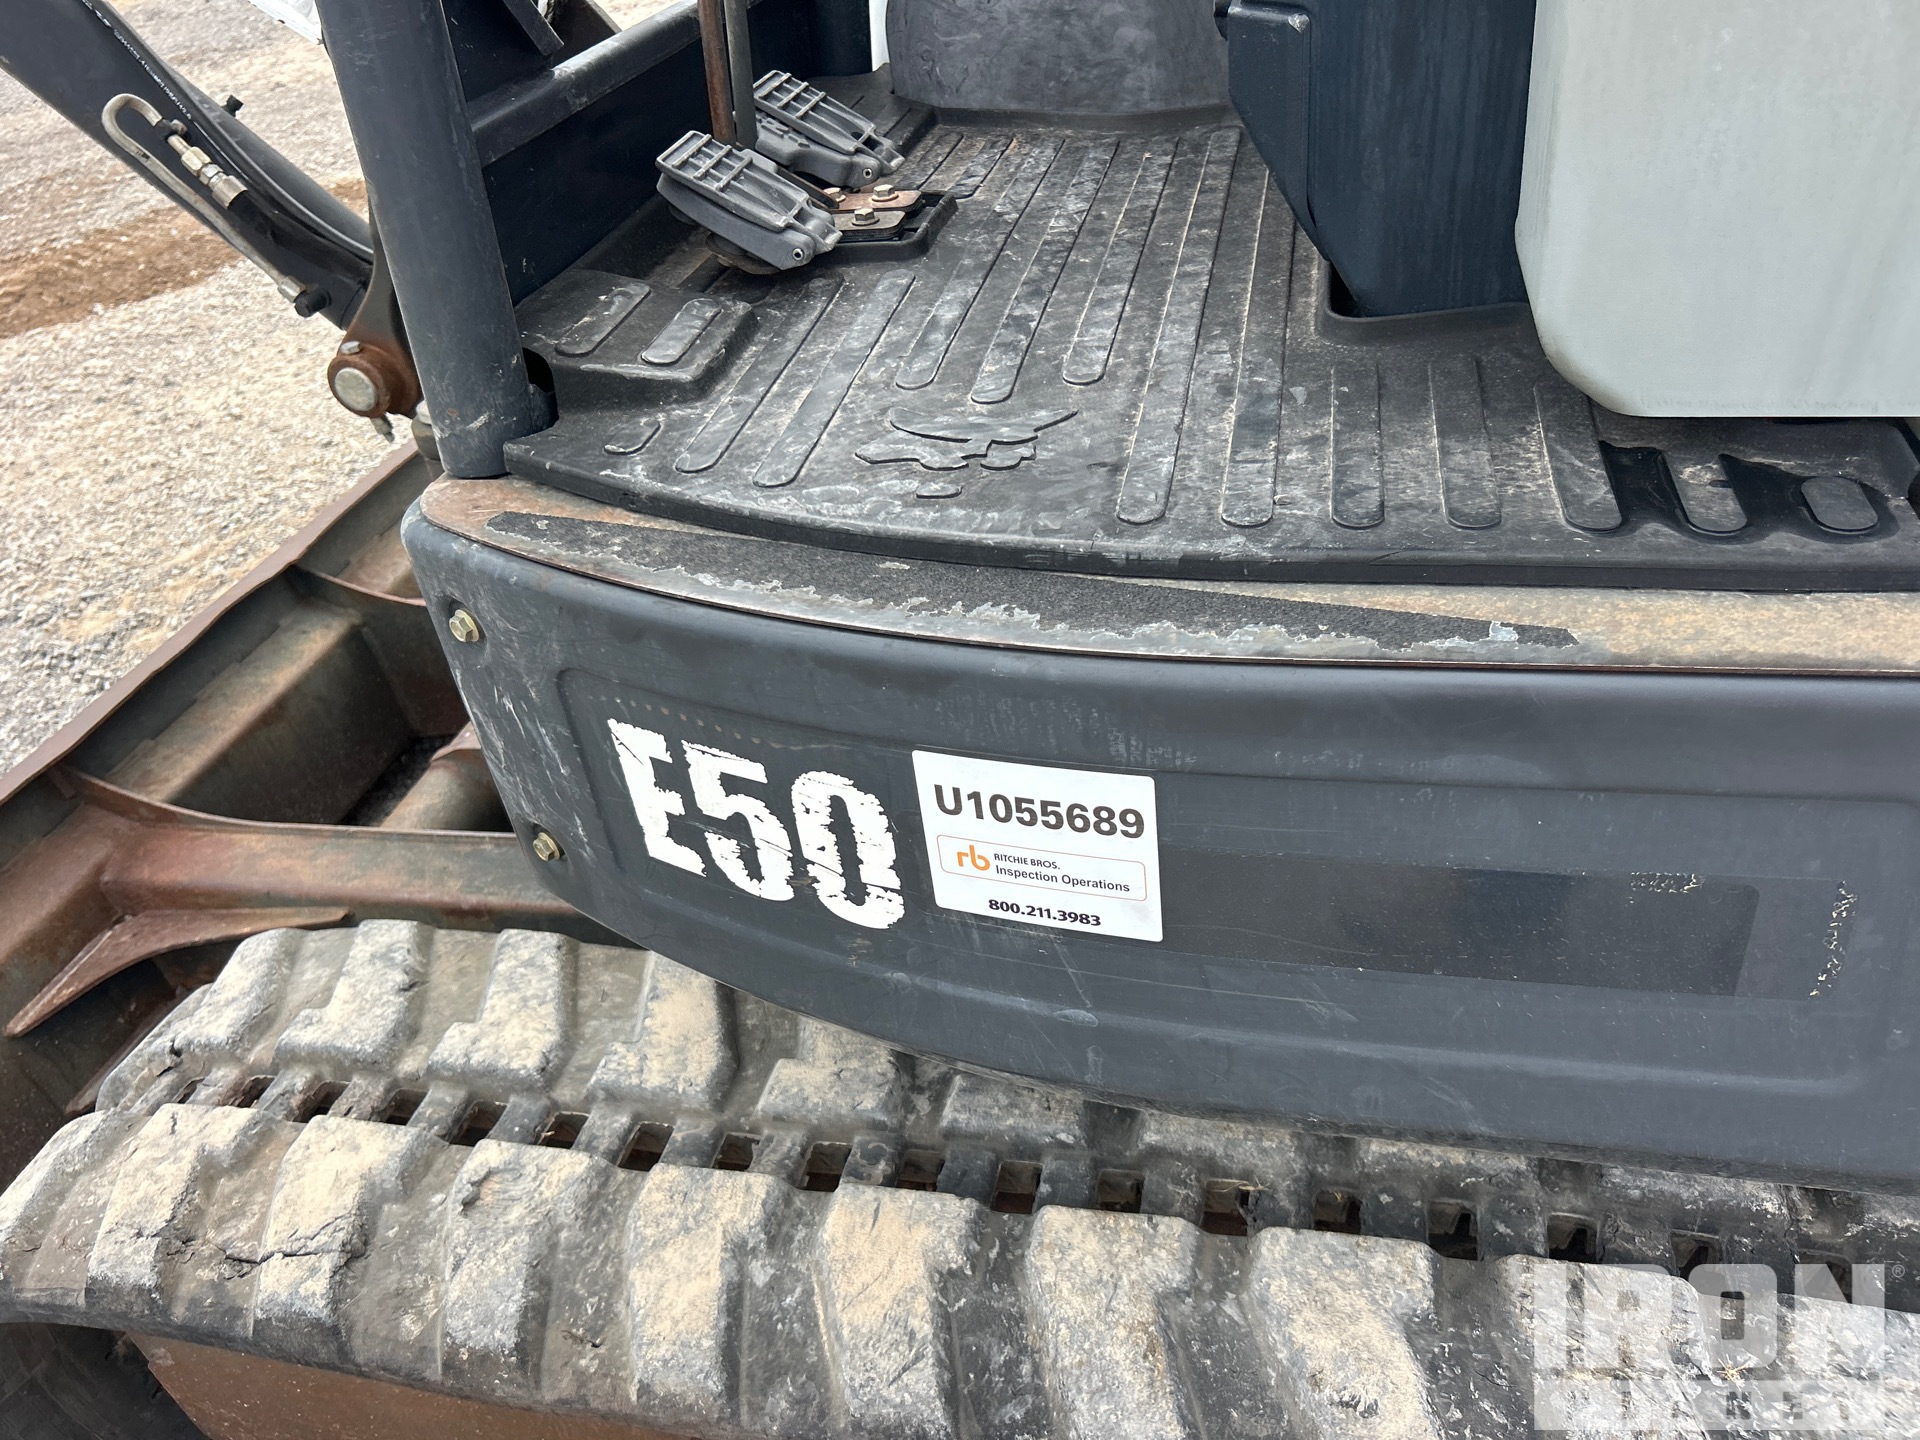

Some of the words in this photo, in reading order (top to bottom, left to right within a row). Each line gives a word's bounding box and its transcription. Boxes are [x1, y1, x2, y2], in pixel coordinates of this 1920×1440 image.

[607, 717, 905, 929] E50
[933, 783, 1145, 839] U1055689
[956, 844, 991, 871] rb
[993, 853, 1029, 865] RITCHIE
[1030, 858, 1061, 870] BROS.
[995, 864, 1058, 884] Inspection
[1061, 874, 1131, 892] Operations
[988, 898, 1102, 926] 800.211.3983
